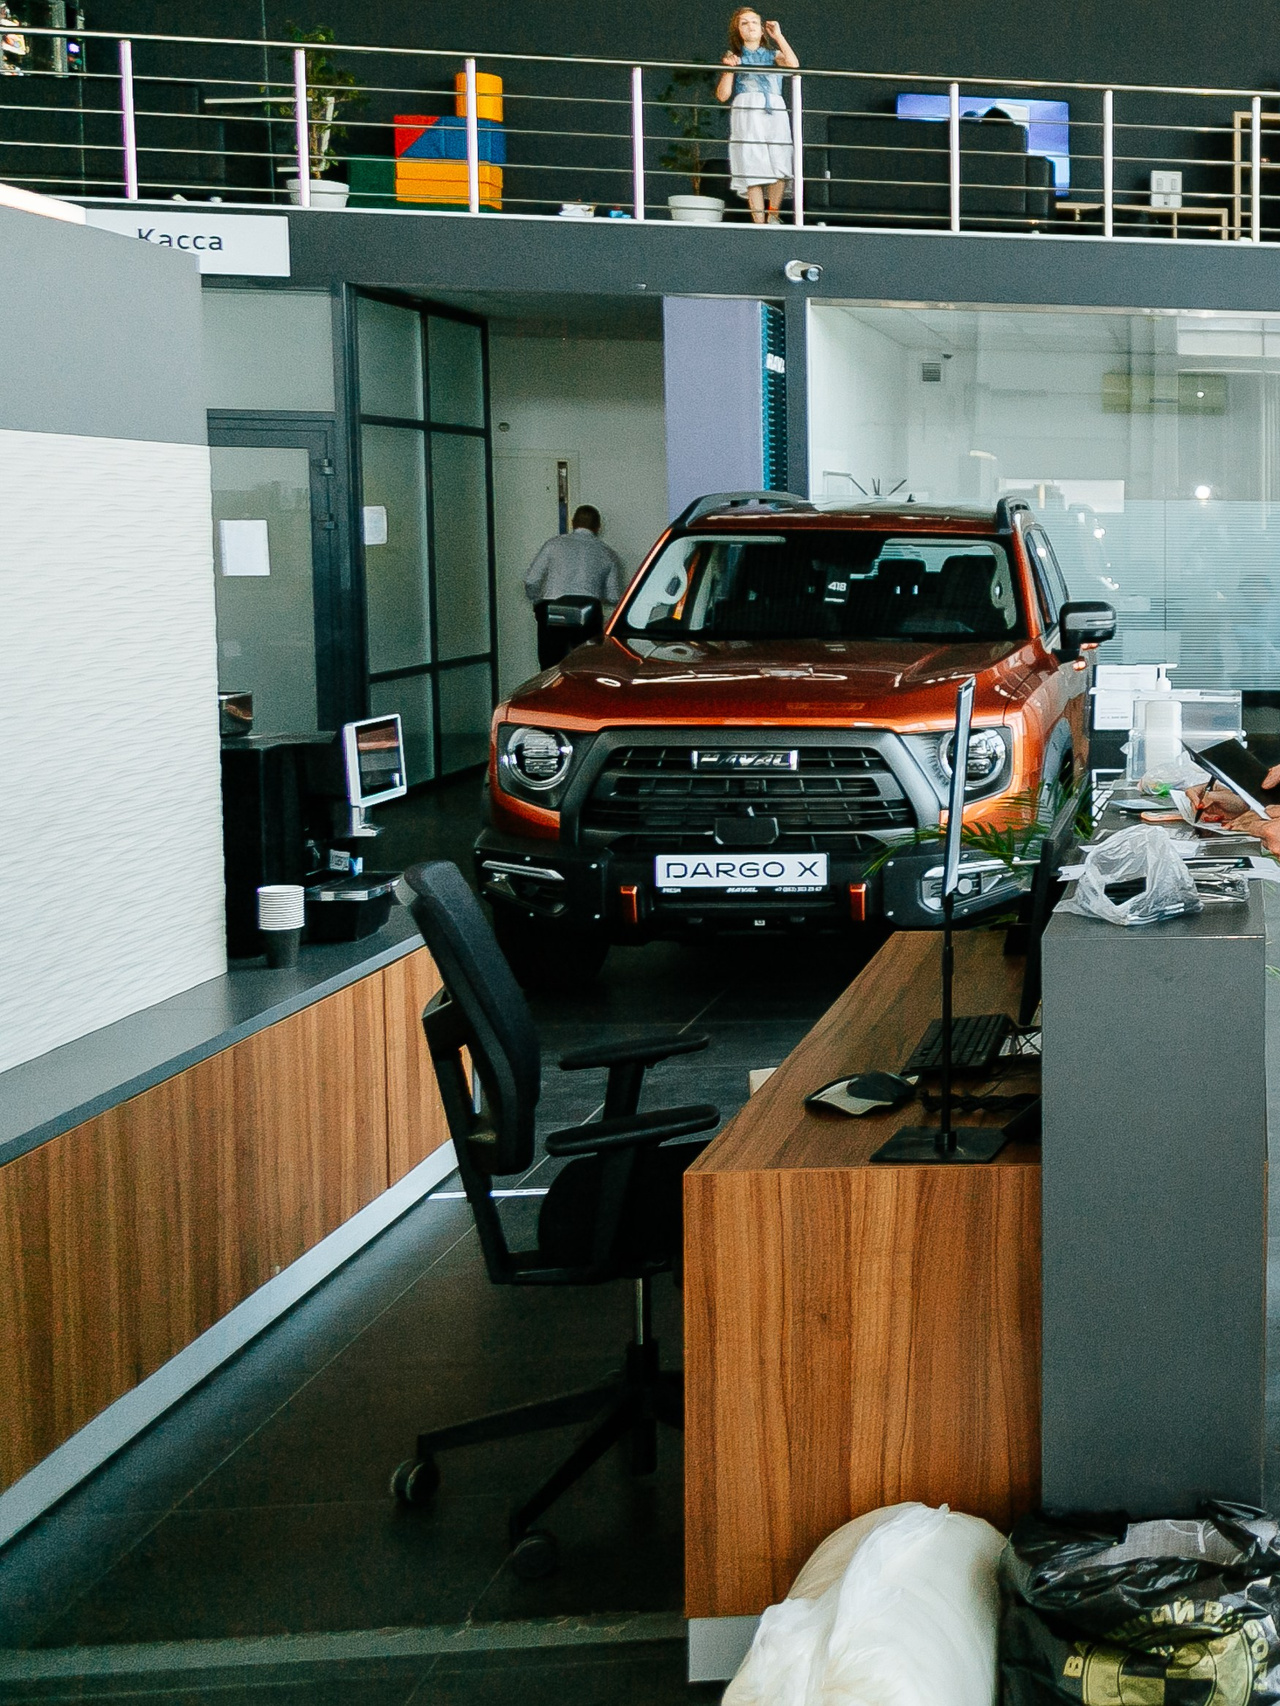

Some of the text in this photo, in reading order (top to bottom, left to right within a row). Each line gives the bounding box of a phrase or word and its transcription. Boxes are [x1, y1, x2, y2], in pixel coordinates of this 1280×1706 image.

[137, 228, 223, 251] Касса
[665, 860, 820, 879] DARGO X
